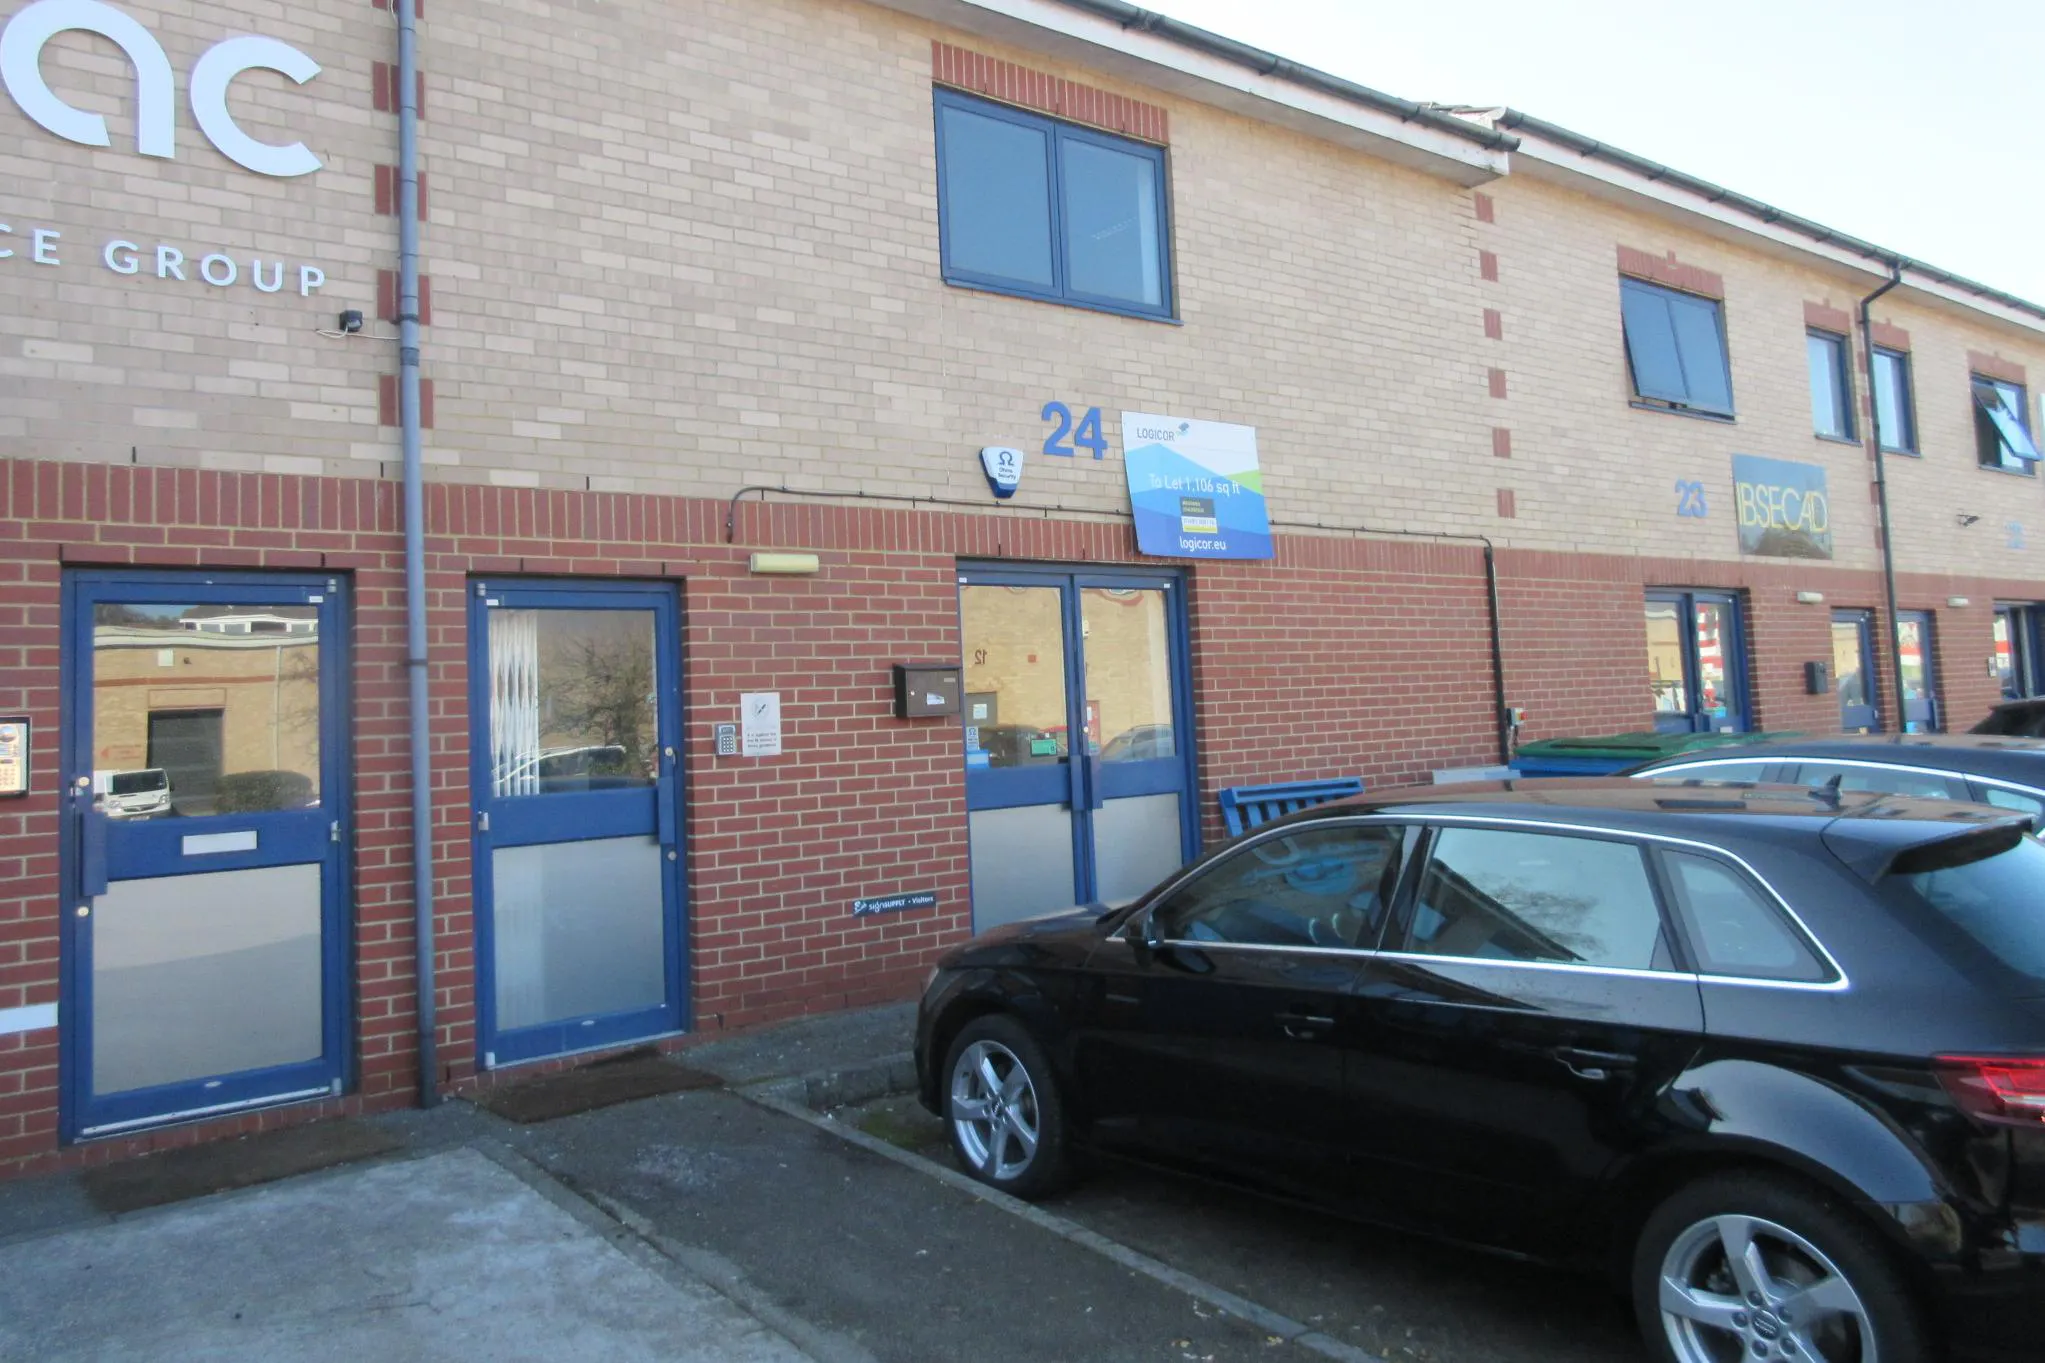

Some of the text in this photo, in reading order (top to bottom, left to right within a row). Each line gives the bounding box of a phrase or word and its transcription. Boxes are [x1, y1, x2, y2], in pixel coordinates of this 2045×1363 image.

[104, 239, 326, 297] GROUP
[1041, 400, 1108, 461] 24
[1136, 427, 1175, 442] LOGICOR
[1149, 473, 1162, 488] To
[1163, 474, 1183, 490] Let
[1216, 482, 1230, 497] sq
[1231, 479, 1240, 494] ft
[1674, 479, 1708, 519] 23
[1179, 536, 1227, 552] logicor.eu
